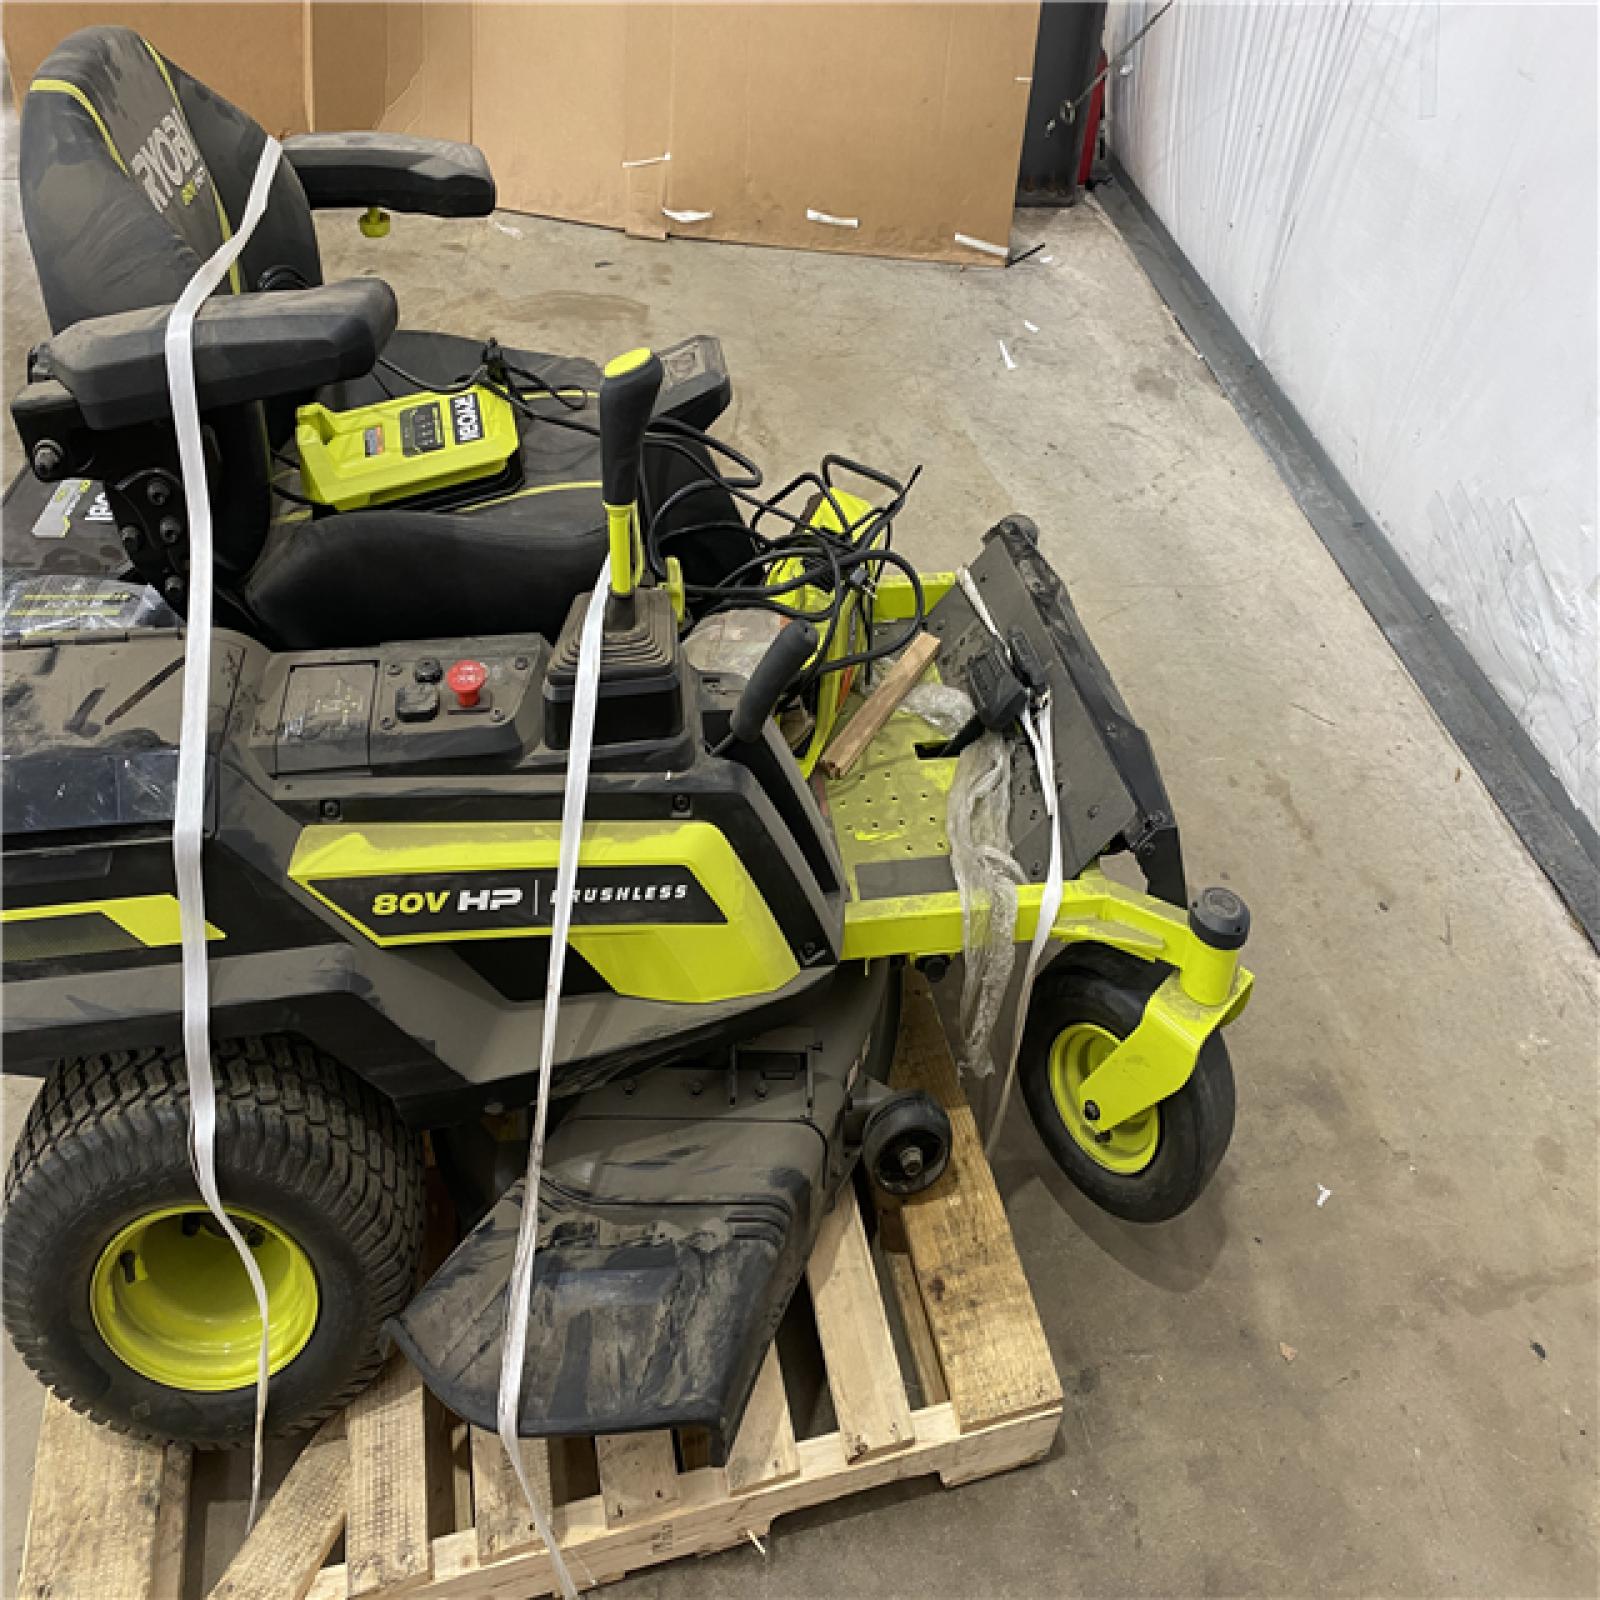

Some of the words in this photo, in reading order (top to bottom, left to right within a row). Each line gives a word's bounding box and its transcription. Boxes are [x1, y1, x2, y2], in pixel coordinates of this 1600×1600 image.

[454, 394, 480, 441] RYOBI
[372, 891, 450, 915] 80V
[457, 889, 523, 912] HP
